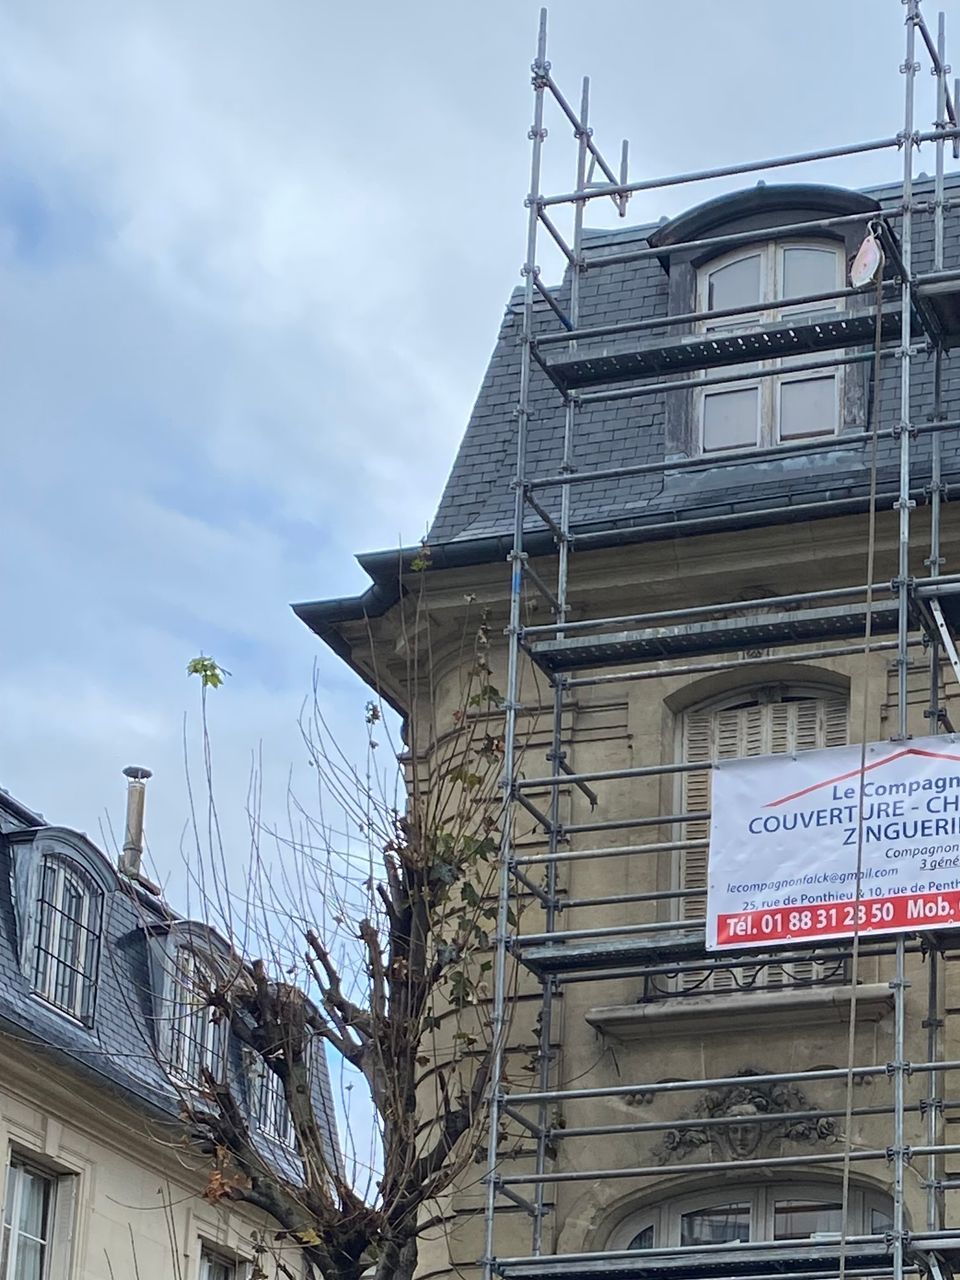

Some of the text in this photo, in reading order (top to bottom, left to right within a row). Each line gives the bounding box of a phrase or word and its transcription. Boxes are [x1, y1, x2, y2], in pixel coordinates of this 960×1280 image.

[832, 785, 856, 801] Le
[749, 800, 905, 834] COUVERTURE
[885, 843, 959, 860] Compagnon
[920, 859, 927, 870] 3
[742, 902, 759, 912] 25,
[762, 899, 780, 909] rue
[783, 896, 798, 907] de
[801, 891, 853, 904] Ponthieu
[869, 887, 885, 898] 10,
[888, 886, 907, 895] rue
[910, 882, 925, 893] de
[726, 915, 757, 937] Tél.
[762, 913, 782, 933] 01
[789, 911, 812, 931] 88
[816, 908, 837, 928] 31
[871, 902, 894, 922] 50
[907, 897, 954, 919] Mob.
